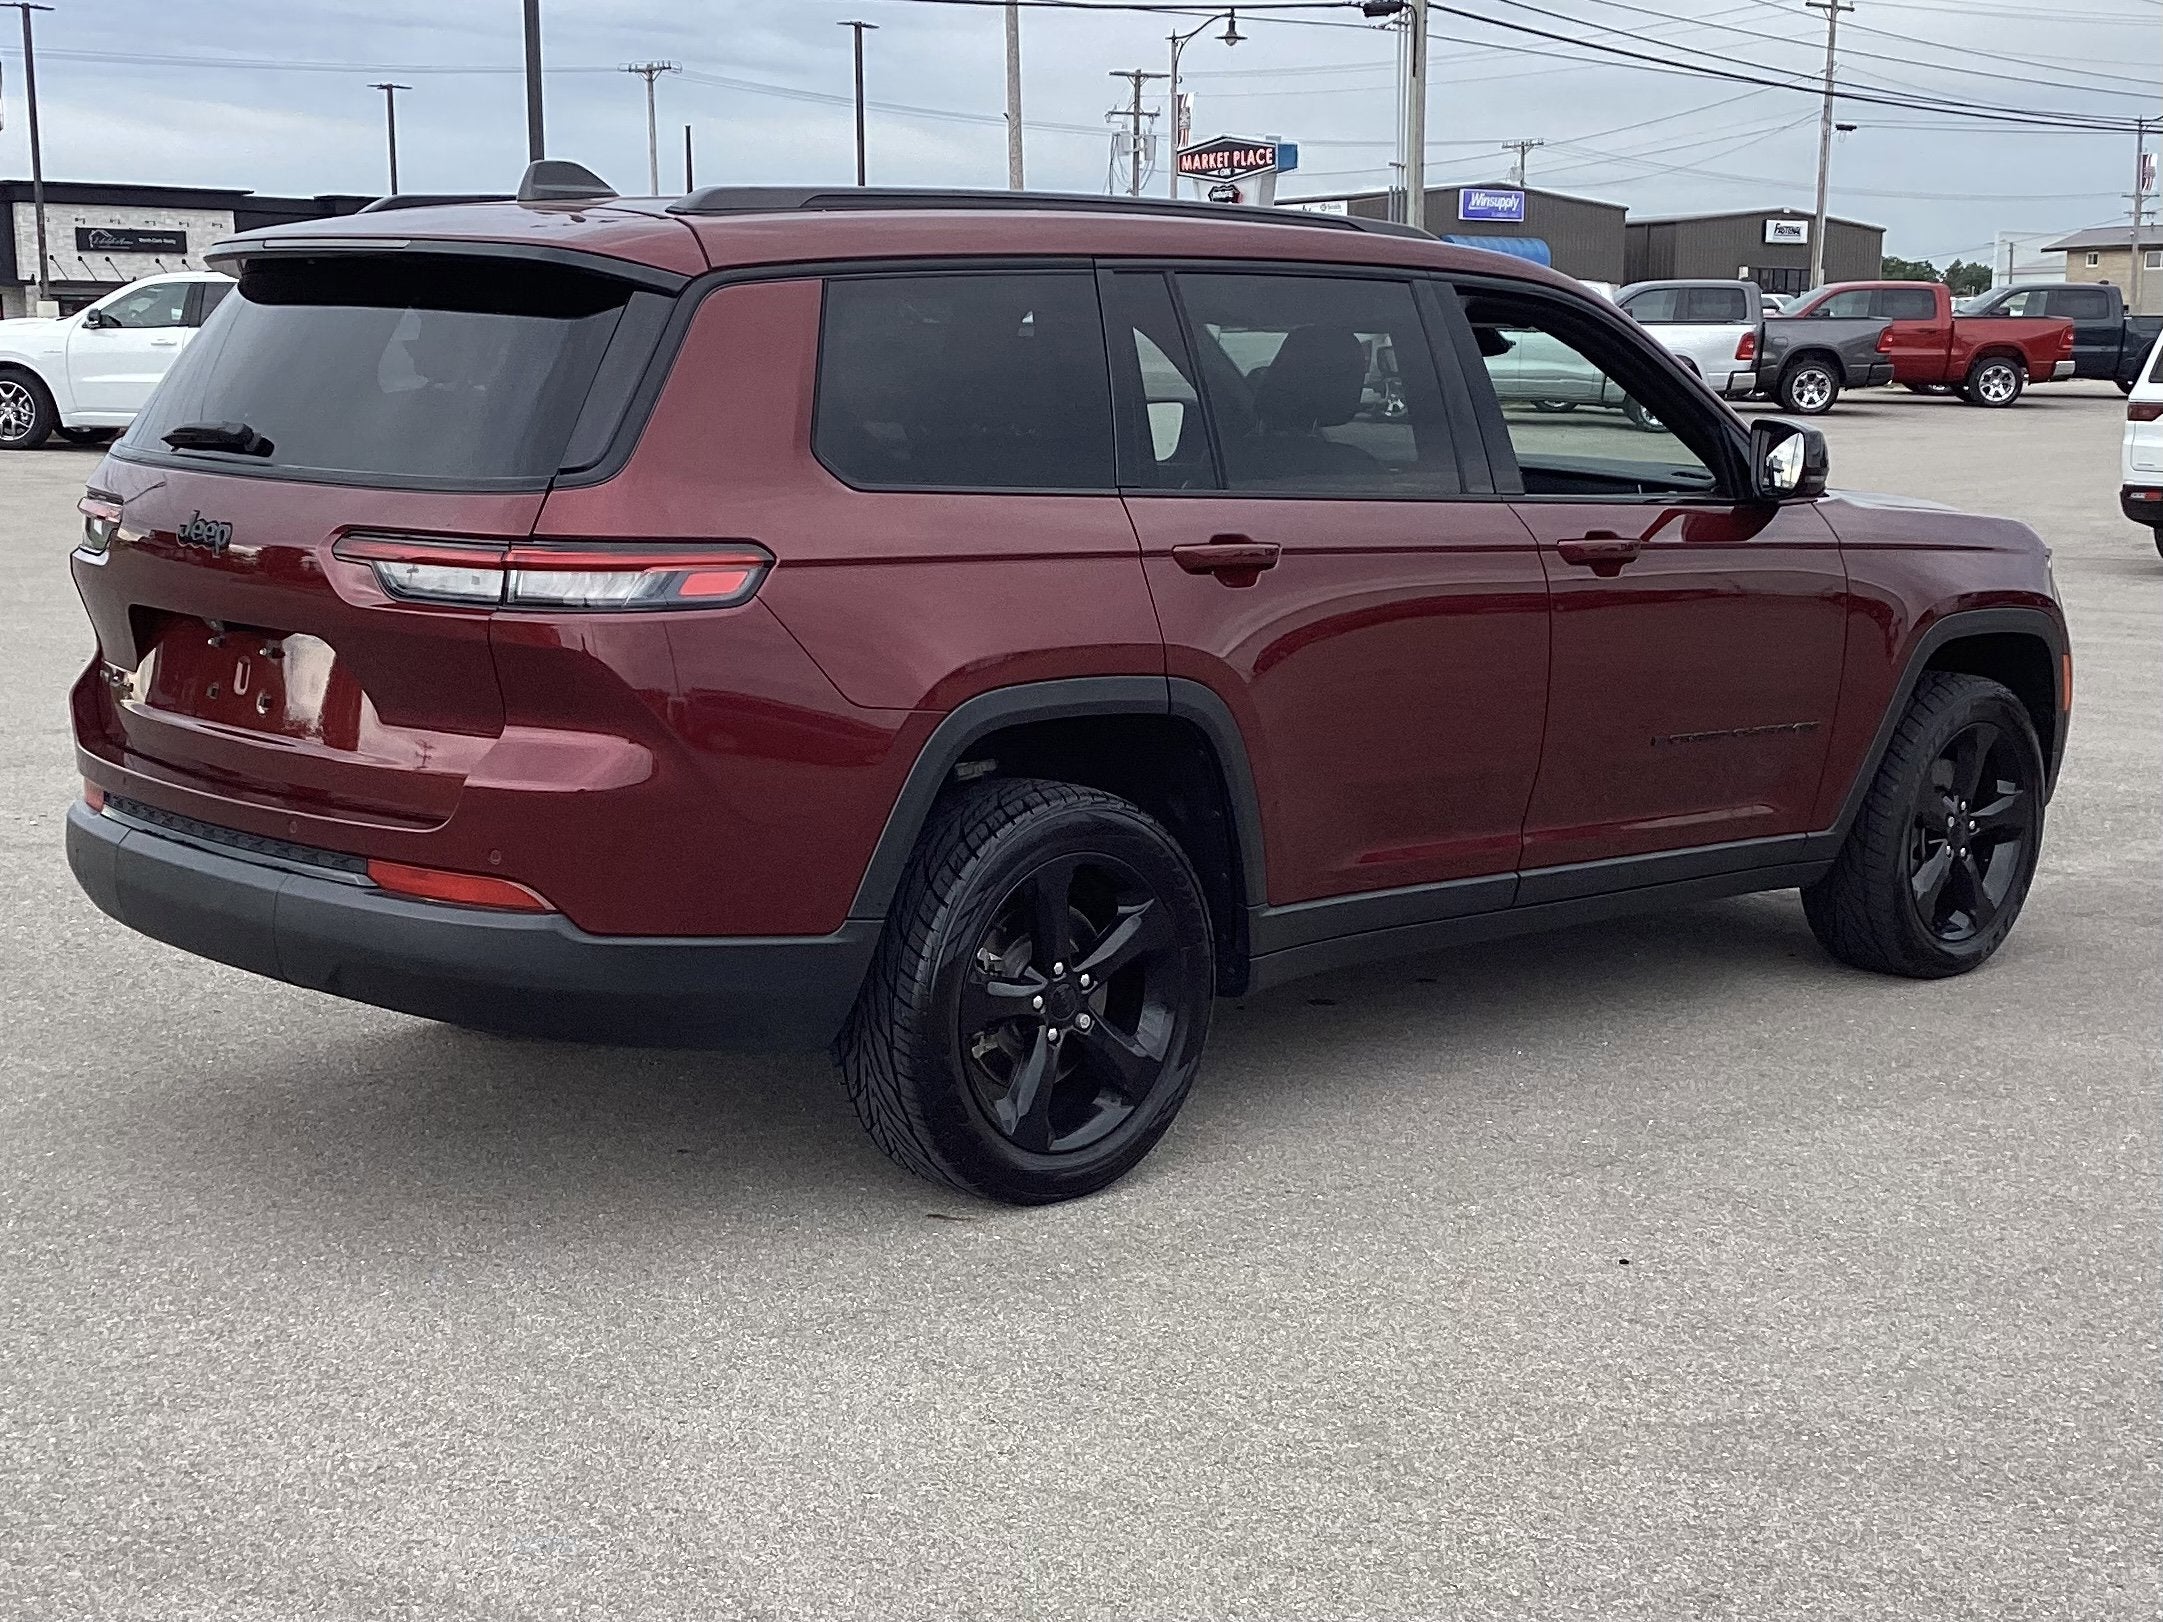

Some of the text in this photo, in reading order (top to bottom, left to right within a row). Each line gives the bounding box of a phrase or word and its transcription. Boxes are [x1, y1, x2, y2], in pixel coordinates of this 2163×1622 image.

[1181, 148, 1273, 171] MARKET PLACE
[1470, 192, 1519, 211] Winsupply
[177, 509, 233, 556] Jeep
